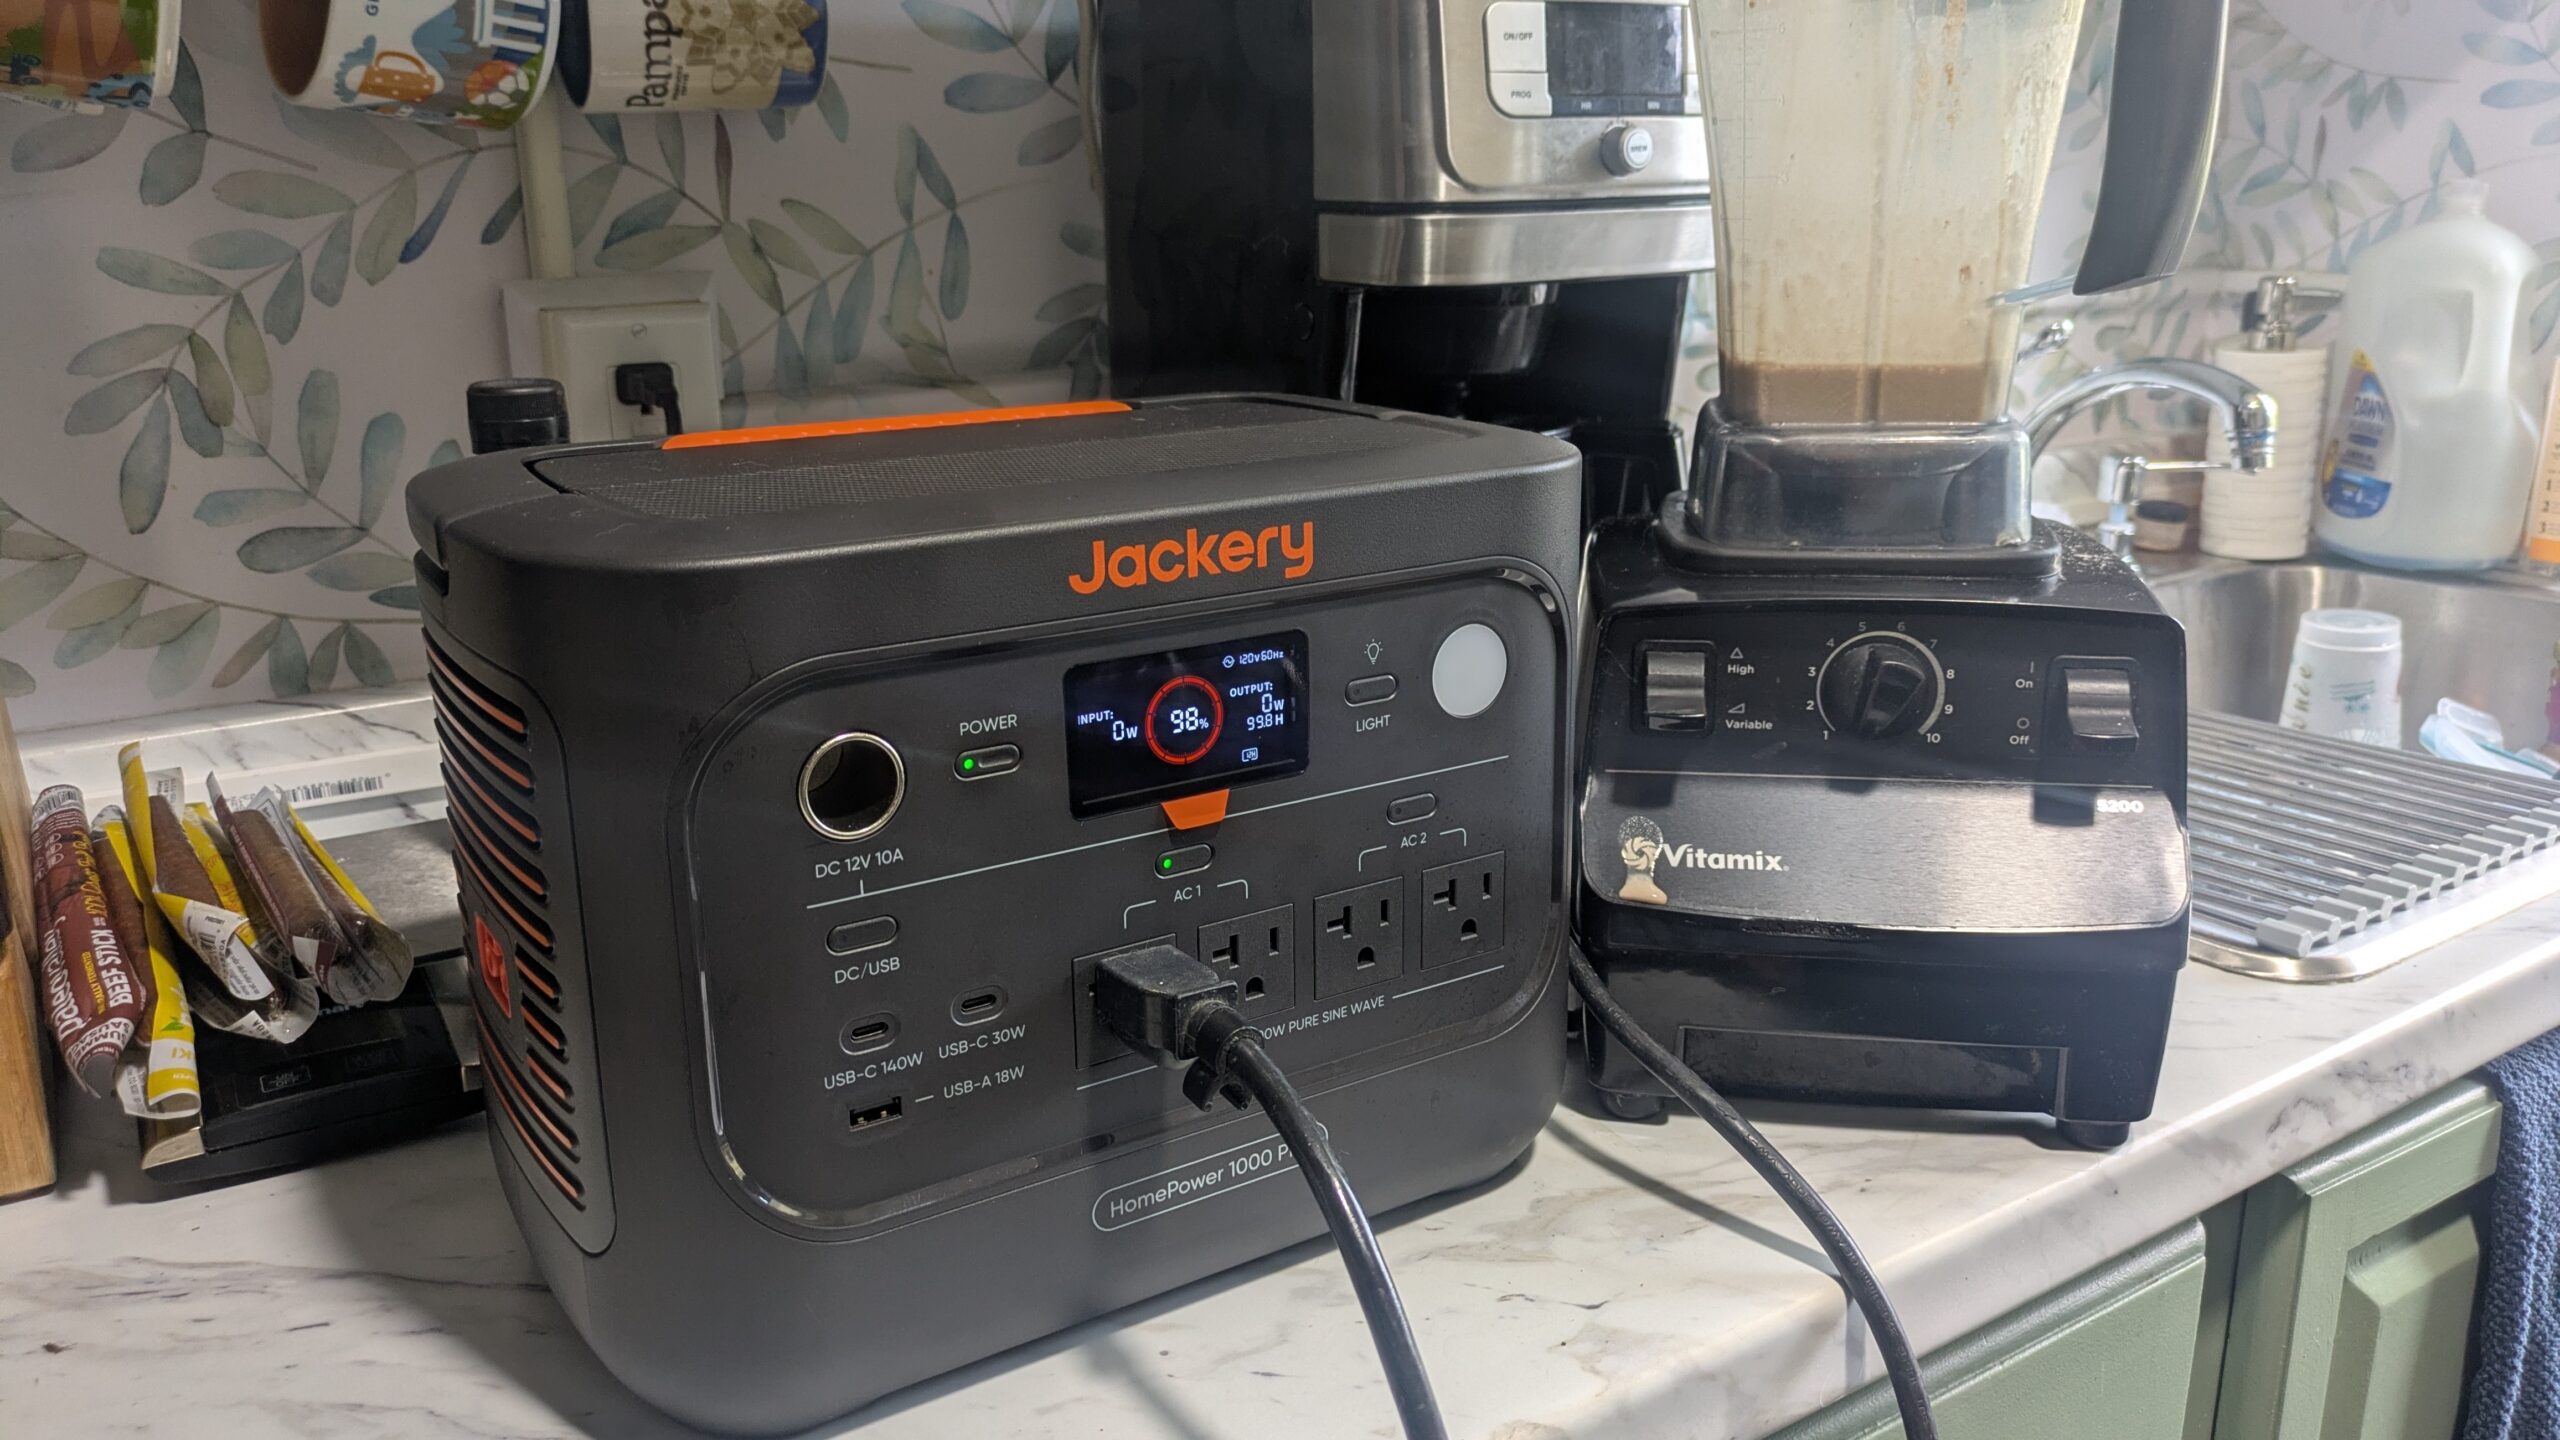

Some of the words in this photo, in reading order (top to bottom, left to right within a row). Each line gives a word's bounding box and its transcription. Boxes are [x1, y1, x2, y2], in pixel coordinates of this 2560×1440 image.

[1503, 32, 1533, 41] ON/OFF
[1510, 89, 1532, 99] PROG
[1068, 521, 1313, 594] Jackery
[1858, 621, 1867, 632] 5
[1897, 621, 1906, 633] 6
[1826, 637, 1836, 648] 4
[1929, 639, 1939, 650] 7
[1727, 663, 1755, 676] High
[1807, 666, 1816, 678] 3
[1946, 669, 1955, 680] 8
[1229, 681, 1273, 698] OUTPUT:
[2015, 678, 2033, 689] On
[1805, 700, 1815, 711] 2
[1944, 704, 1954, 715] 9
[959, 714, 1018, 736] POWER
[1077, 710, 1114, 726] INPUT:
[1170, 706, 1209, 734] 98%
[1356, 714, 1391, 732] LIGHT
[1725, 718, 1773, 731] Variable
[1822, 730, 1829, 741] 1
[1926, 732, 1942, 744] 10
[2009, 735, 2030, 746] Off
[1400, 835, 1417, 848] AC
[1419, 832, 1427, 845] 2
[815, 859, 841, 879] DC
[844, 854, 871, 873] 12V
[875, 847, 904, 867] 10A
[1173, 886, 1195, 903] AC
[1196, 884, 1202, 897] 1
[90, 929, 122, 967] STICK
[834, 957, 900, 985] DC/USB
[101, 967, 134, 1019] BEEF
[1288, 1014, 1319, 1033] PURE
[1322, 1006, 1348, 1023] SINE
[1350, 995, 1385, 1015] WAVE
[938, 1034, 988, 1060] USB-C
[992, 1025, 1026, 1046] 30W
[824, 1062, 878, 1090] USB-C
[881, 1051, 924, 1076] 140W
[943, 1075, 992, 1099] USB-A
[994, 1065, 1026, 1086] 18W
[1110, 1167, 1224, 1218] HomePower
[1228, 1149, 1273, 1178] 1000
